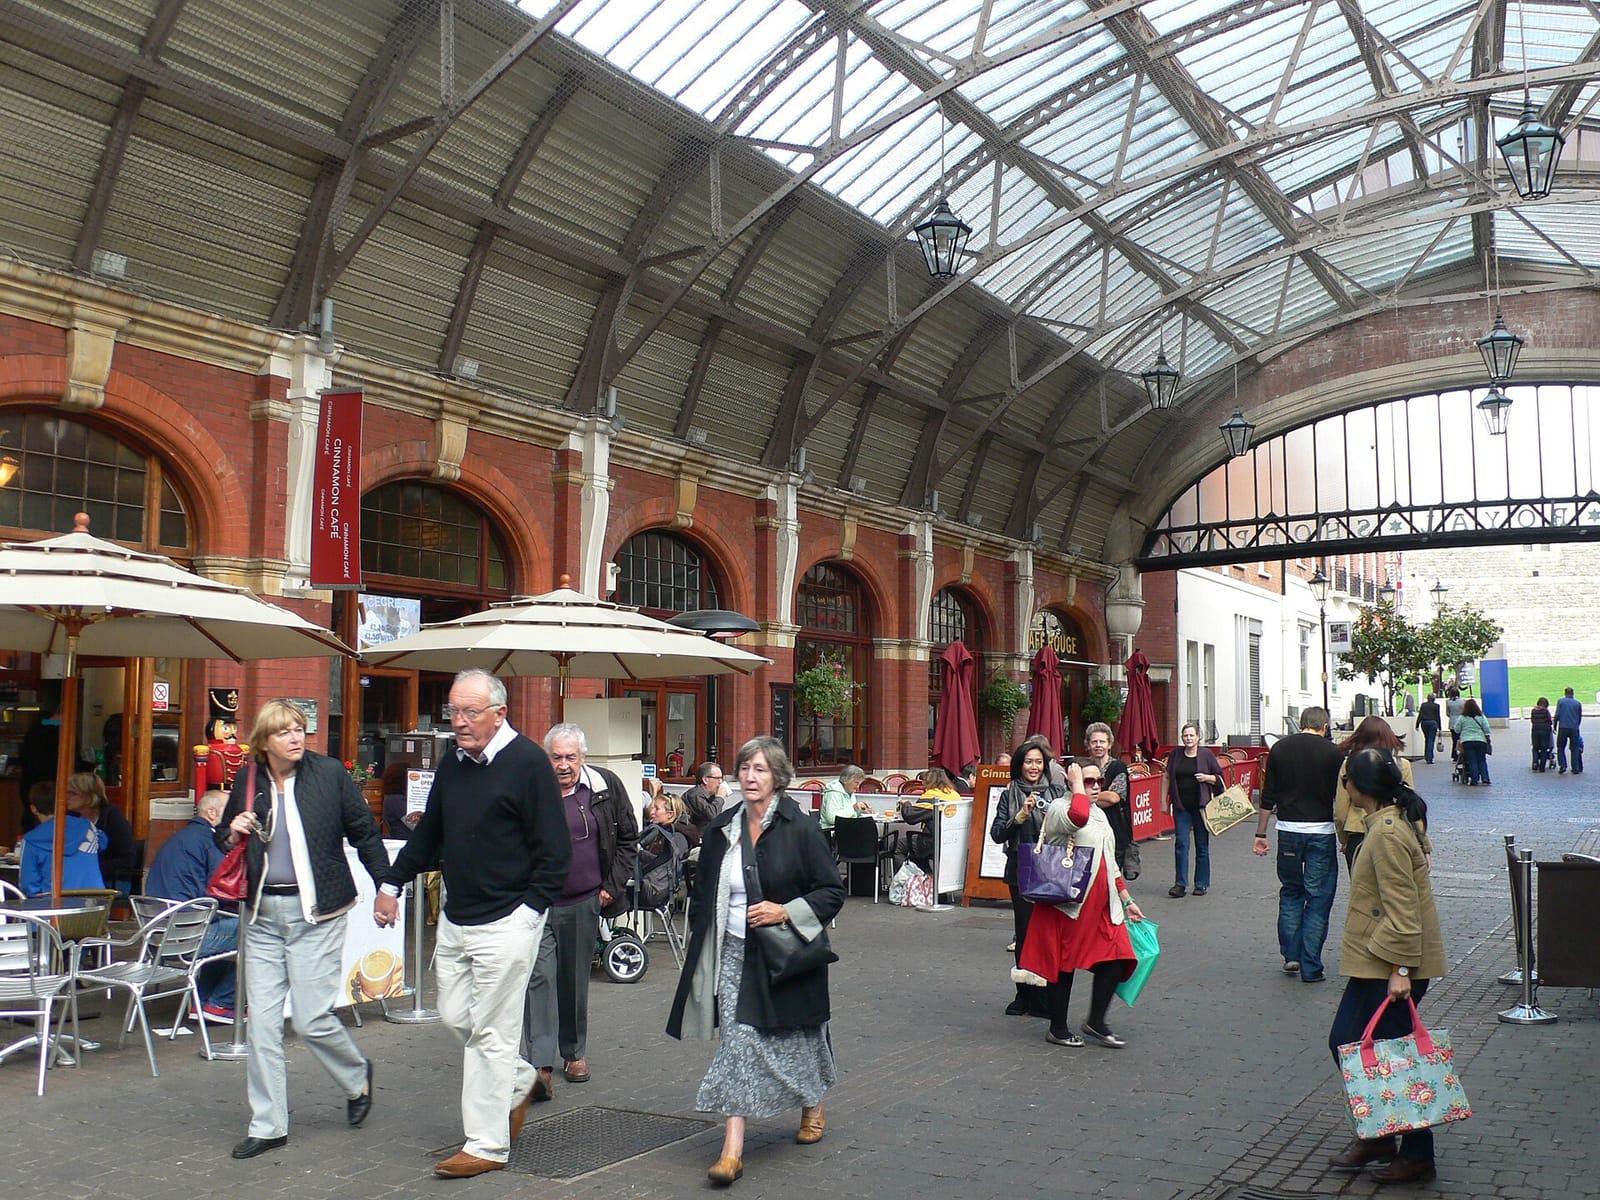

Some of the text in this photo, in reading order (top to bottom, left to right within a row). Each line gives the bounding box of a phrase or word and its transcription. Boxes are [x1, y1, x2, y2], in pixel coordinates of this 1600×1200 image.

[325, 401, 333, 438] CINNAMON
[330, 438, 342, 539] CINNAMON CAFÉ
[1047, 633, 1077, 655] ROUGE
[1135, 789, 1151, 809] CAFÉ
[1133, 808, 1153, 827] ROUGE
